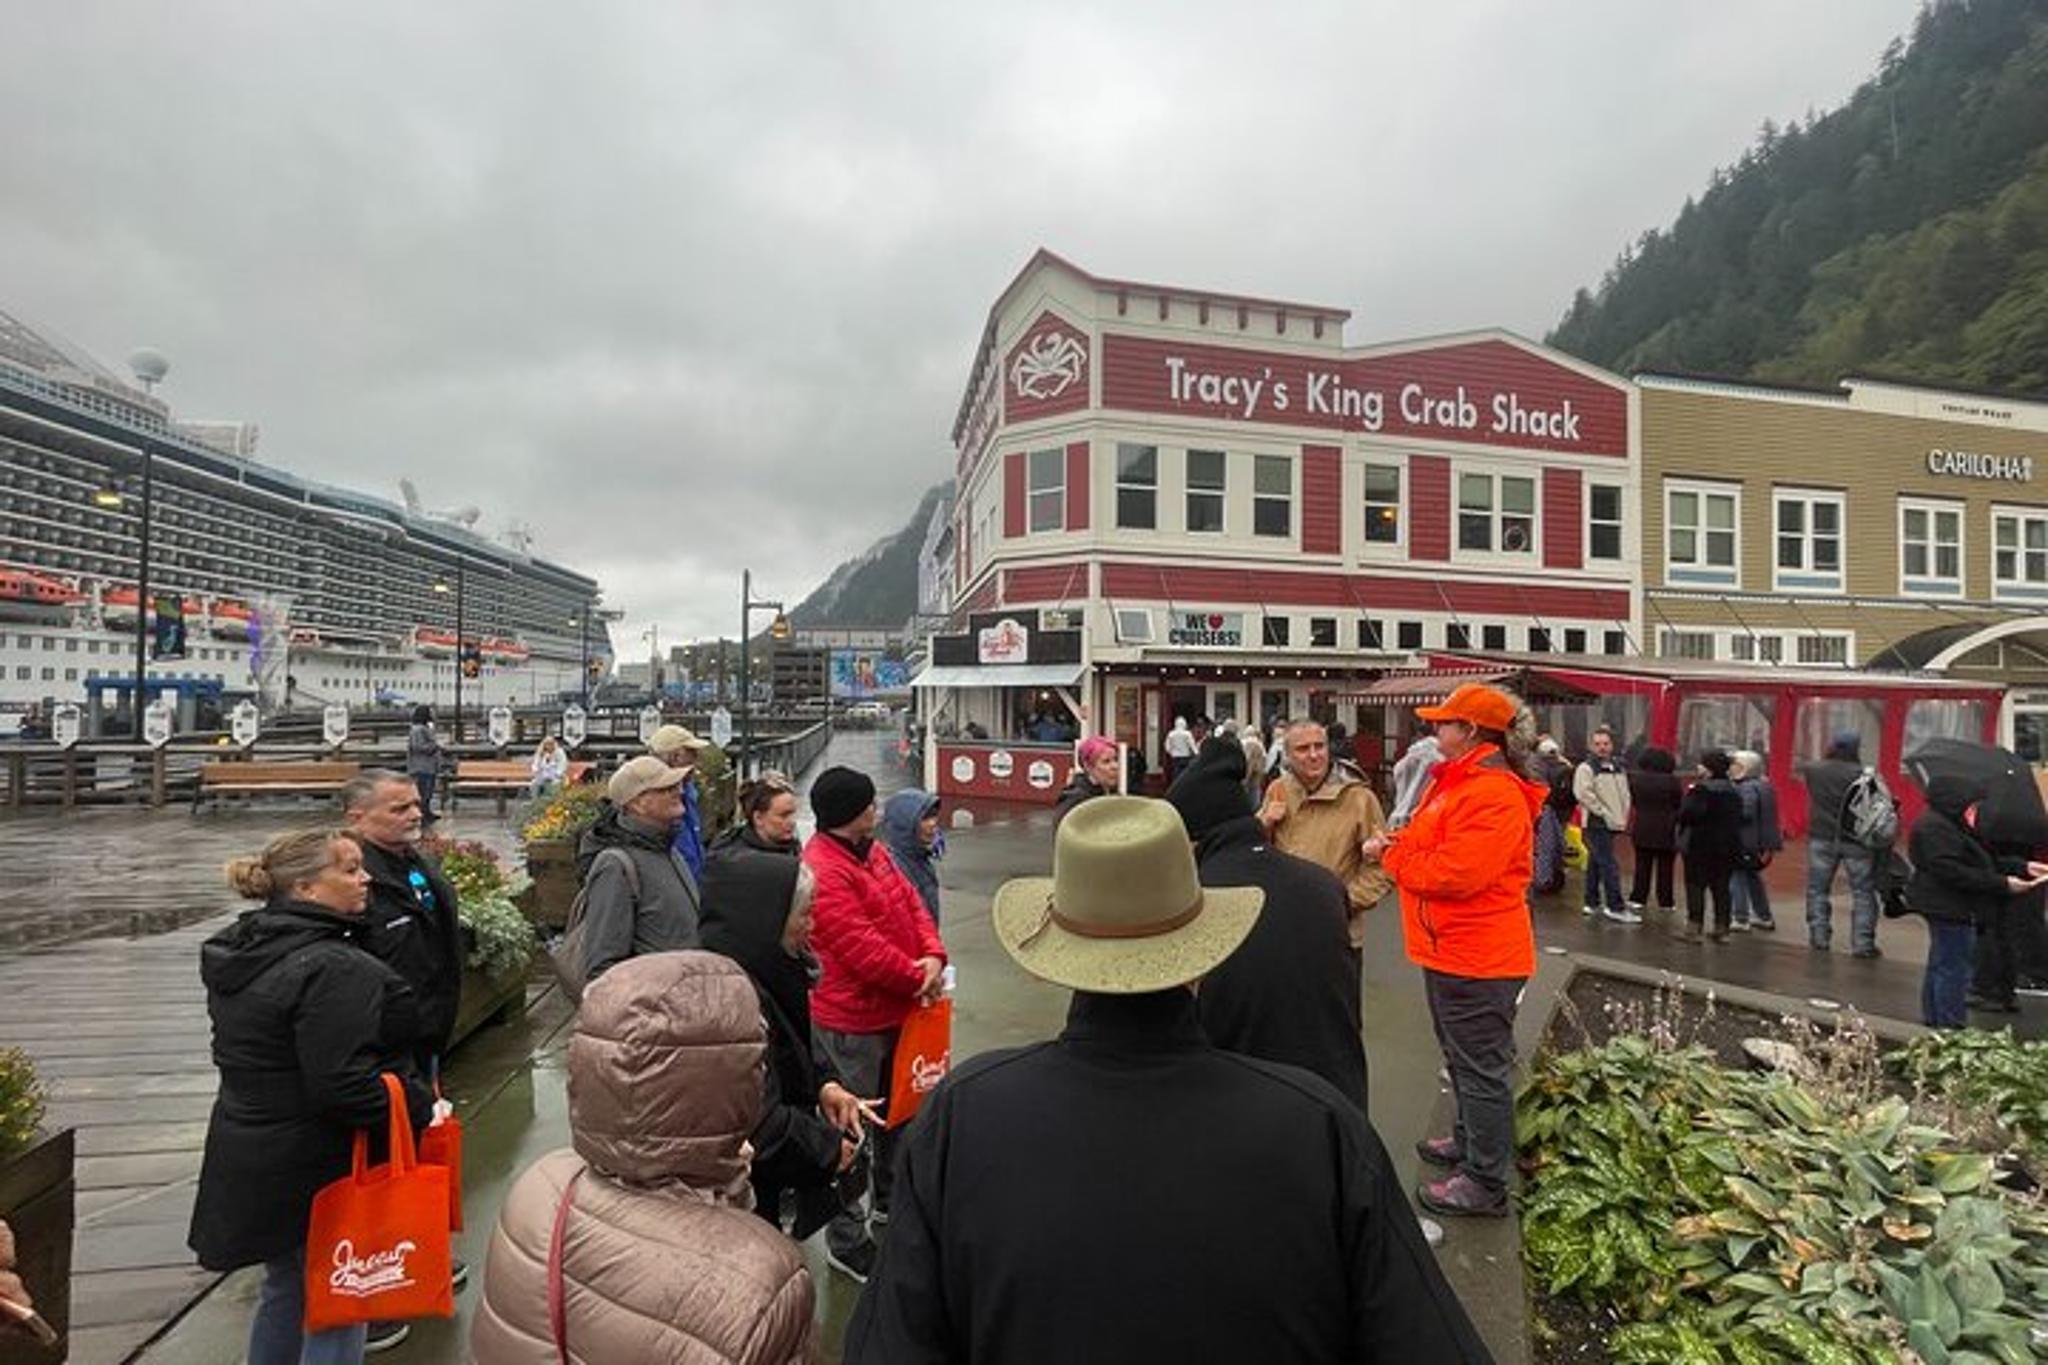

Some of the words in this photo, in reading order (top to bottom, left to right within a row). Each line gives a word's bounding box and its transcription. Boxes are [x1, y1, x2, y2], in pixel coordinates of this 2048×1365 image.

[1165, 357, 1288, 417] Tracy's
[1307, 372, 1384, 431] King
[1400, 384, 1477, 429] Crab
[1492, 393, 1580, 441] Shack
[1928, 448, 2023, 479] CARILOHA
[1186, 613, 1207, 629] WE
